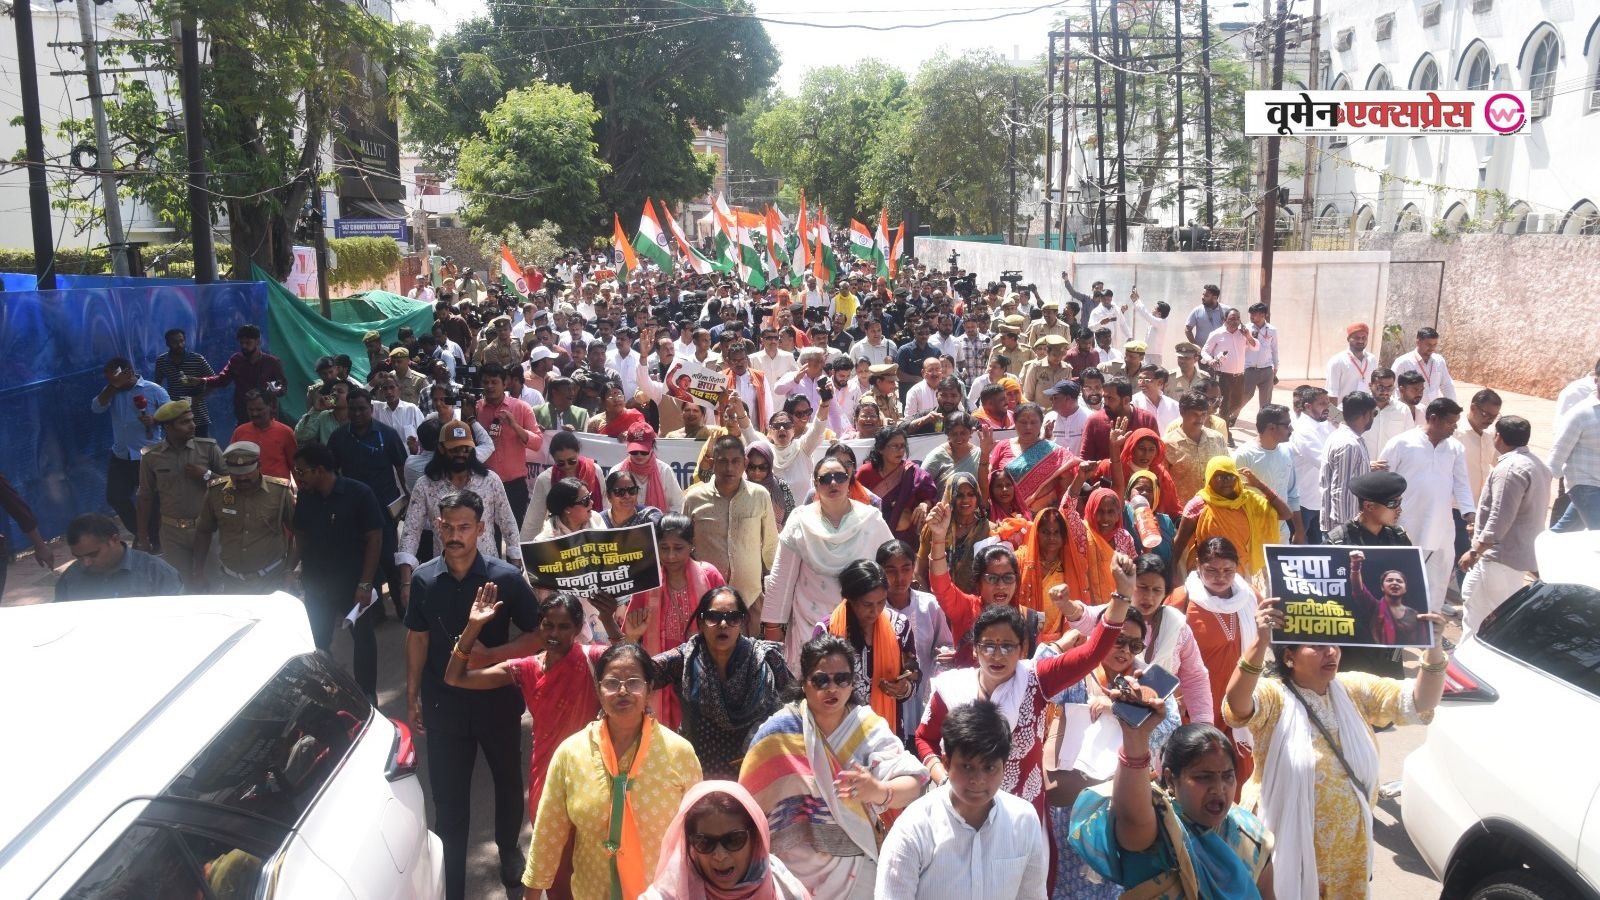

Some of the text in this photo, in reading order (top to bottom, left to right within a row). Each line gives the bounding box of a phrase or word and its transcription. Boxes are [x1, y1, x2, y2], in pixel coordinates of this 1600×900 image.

[360, 139, 386, 159] WALNUT
[697, 380, 717, 391] सपा
[560, 542, 618, 559] सपा का हाथ
[538, 550, 643, 573] नारी शक्ति के खिलाफ
[1278, 555, 1346, 579] सपा की
[555, 566, 630, 588] जनता नहीं
[1283, 576, 1347, 597] पहचान
[1283, 616, 1355, 636] अपमान
